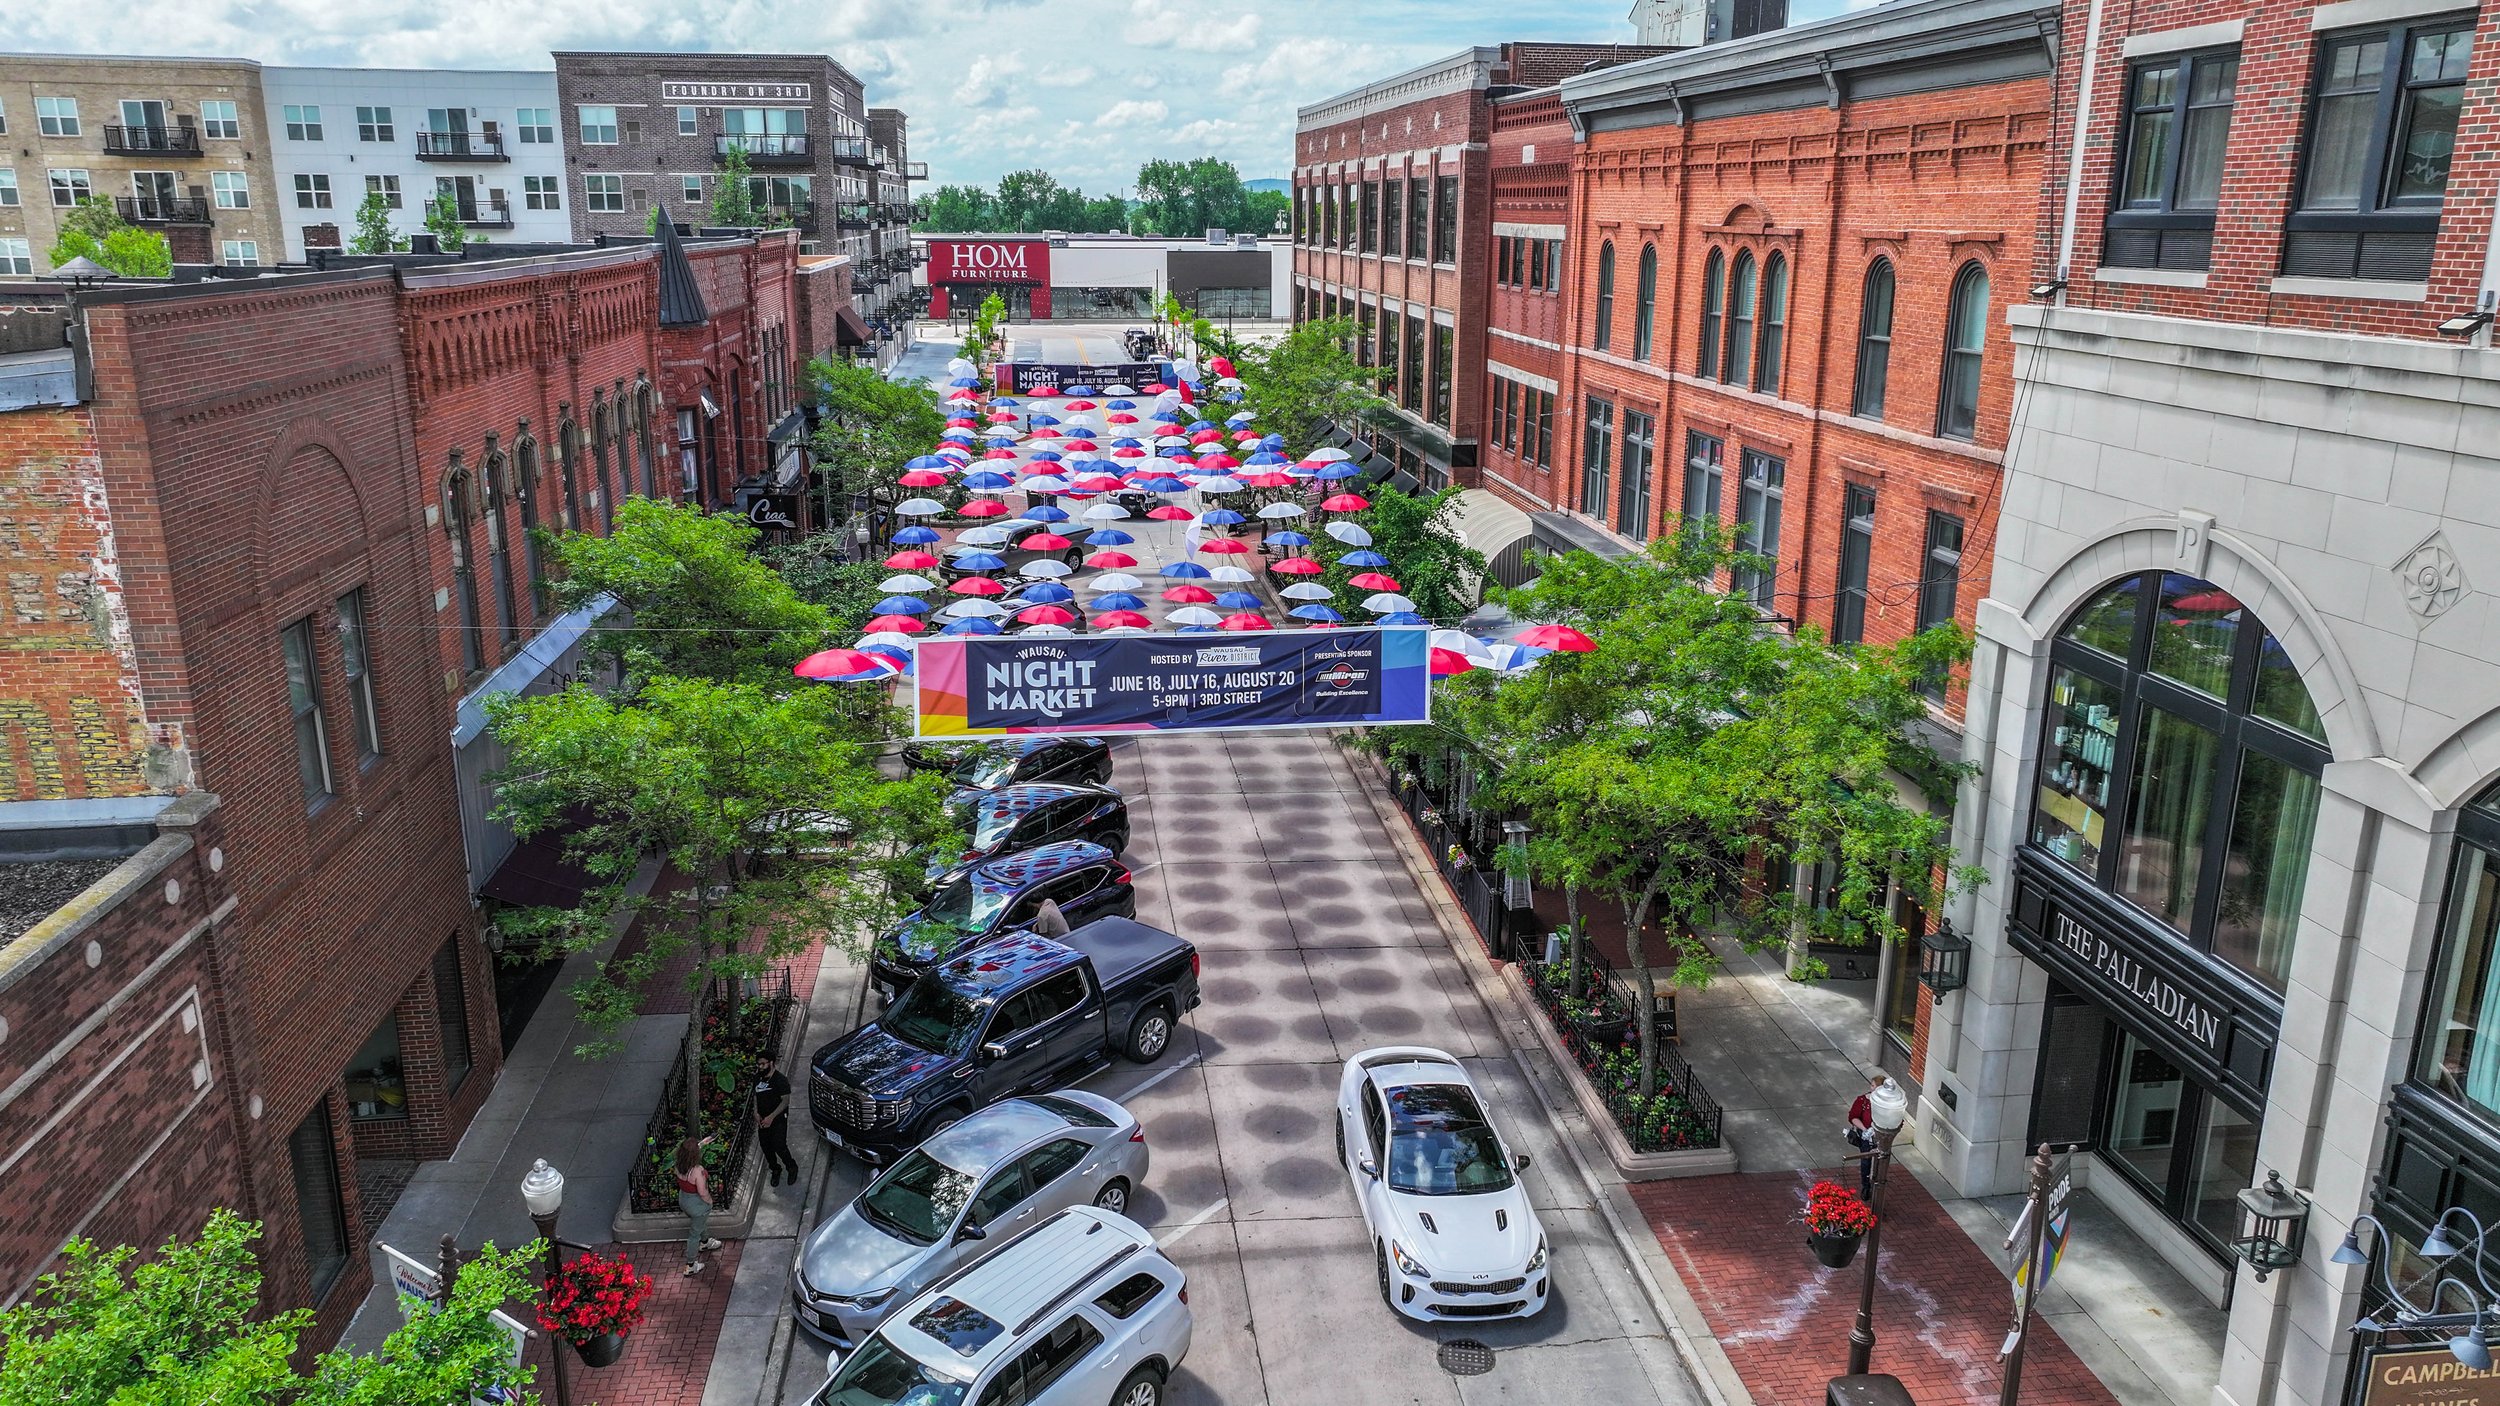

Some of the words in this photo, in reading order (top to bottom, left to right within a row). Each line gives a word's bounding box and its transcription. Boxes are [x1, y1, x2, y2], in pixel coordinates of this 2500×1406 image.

[672, 85, 737, 97] FOUNDRY
[749, 87, 764, 97] ON
[776, 87, 801, 97] 3RD
[951, 244, 1027, 268] HOM
[952, 269, 1028, 278] FURNITURE
[1019, 371, 1059, 381] NIGHT
[751, 499, 796, 528] Ciao
[2179, 525, 2198, 560] P
[1017, 646, 1065, 660] WAUSAU
[1150, 655, 1181, 665] HOSTED
[1182, 654, 1193, 664] BY
[1199, 653, 1229, 662] River
[1230, 652, 1257, 661] DISTRICT
[1315, 651, 1347, 660] PRESENTING
[1347, 650, 1372, 658] SPONSOR
[987, 660, 1097, 688] NIGHT
[1109, 675, 1144, 692] JUNE
[1147, 675, 1165, 692] 18,
[1168, 674, 1200, 691] JULY
[1203, 673, 1220, 691] 16,
[1224, 671, 1276, 689] AUGUST
[1279, 671, 1295, 686] 20
[987, 688, 1097, 717] MARKET
[1152, 694, 1189, 708] 5-9PM
[1200, 693, 1221, 706] 3RD
[1224, 691, 1263, 705] STREET
[2057, 912, 2094, 962] THE
[2094, 938, 2221, 1049] PALLADIAN
[2048, 1174, 2071, 1211] PRIDE
[396, 1264, 427, 1291] Welcome
[396, 1277, 438, 1308] WAUS
